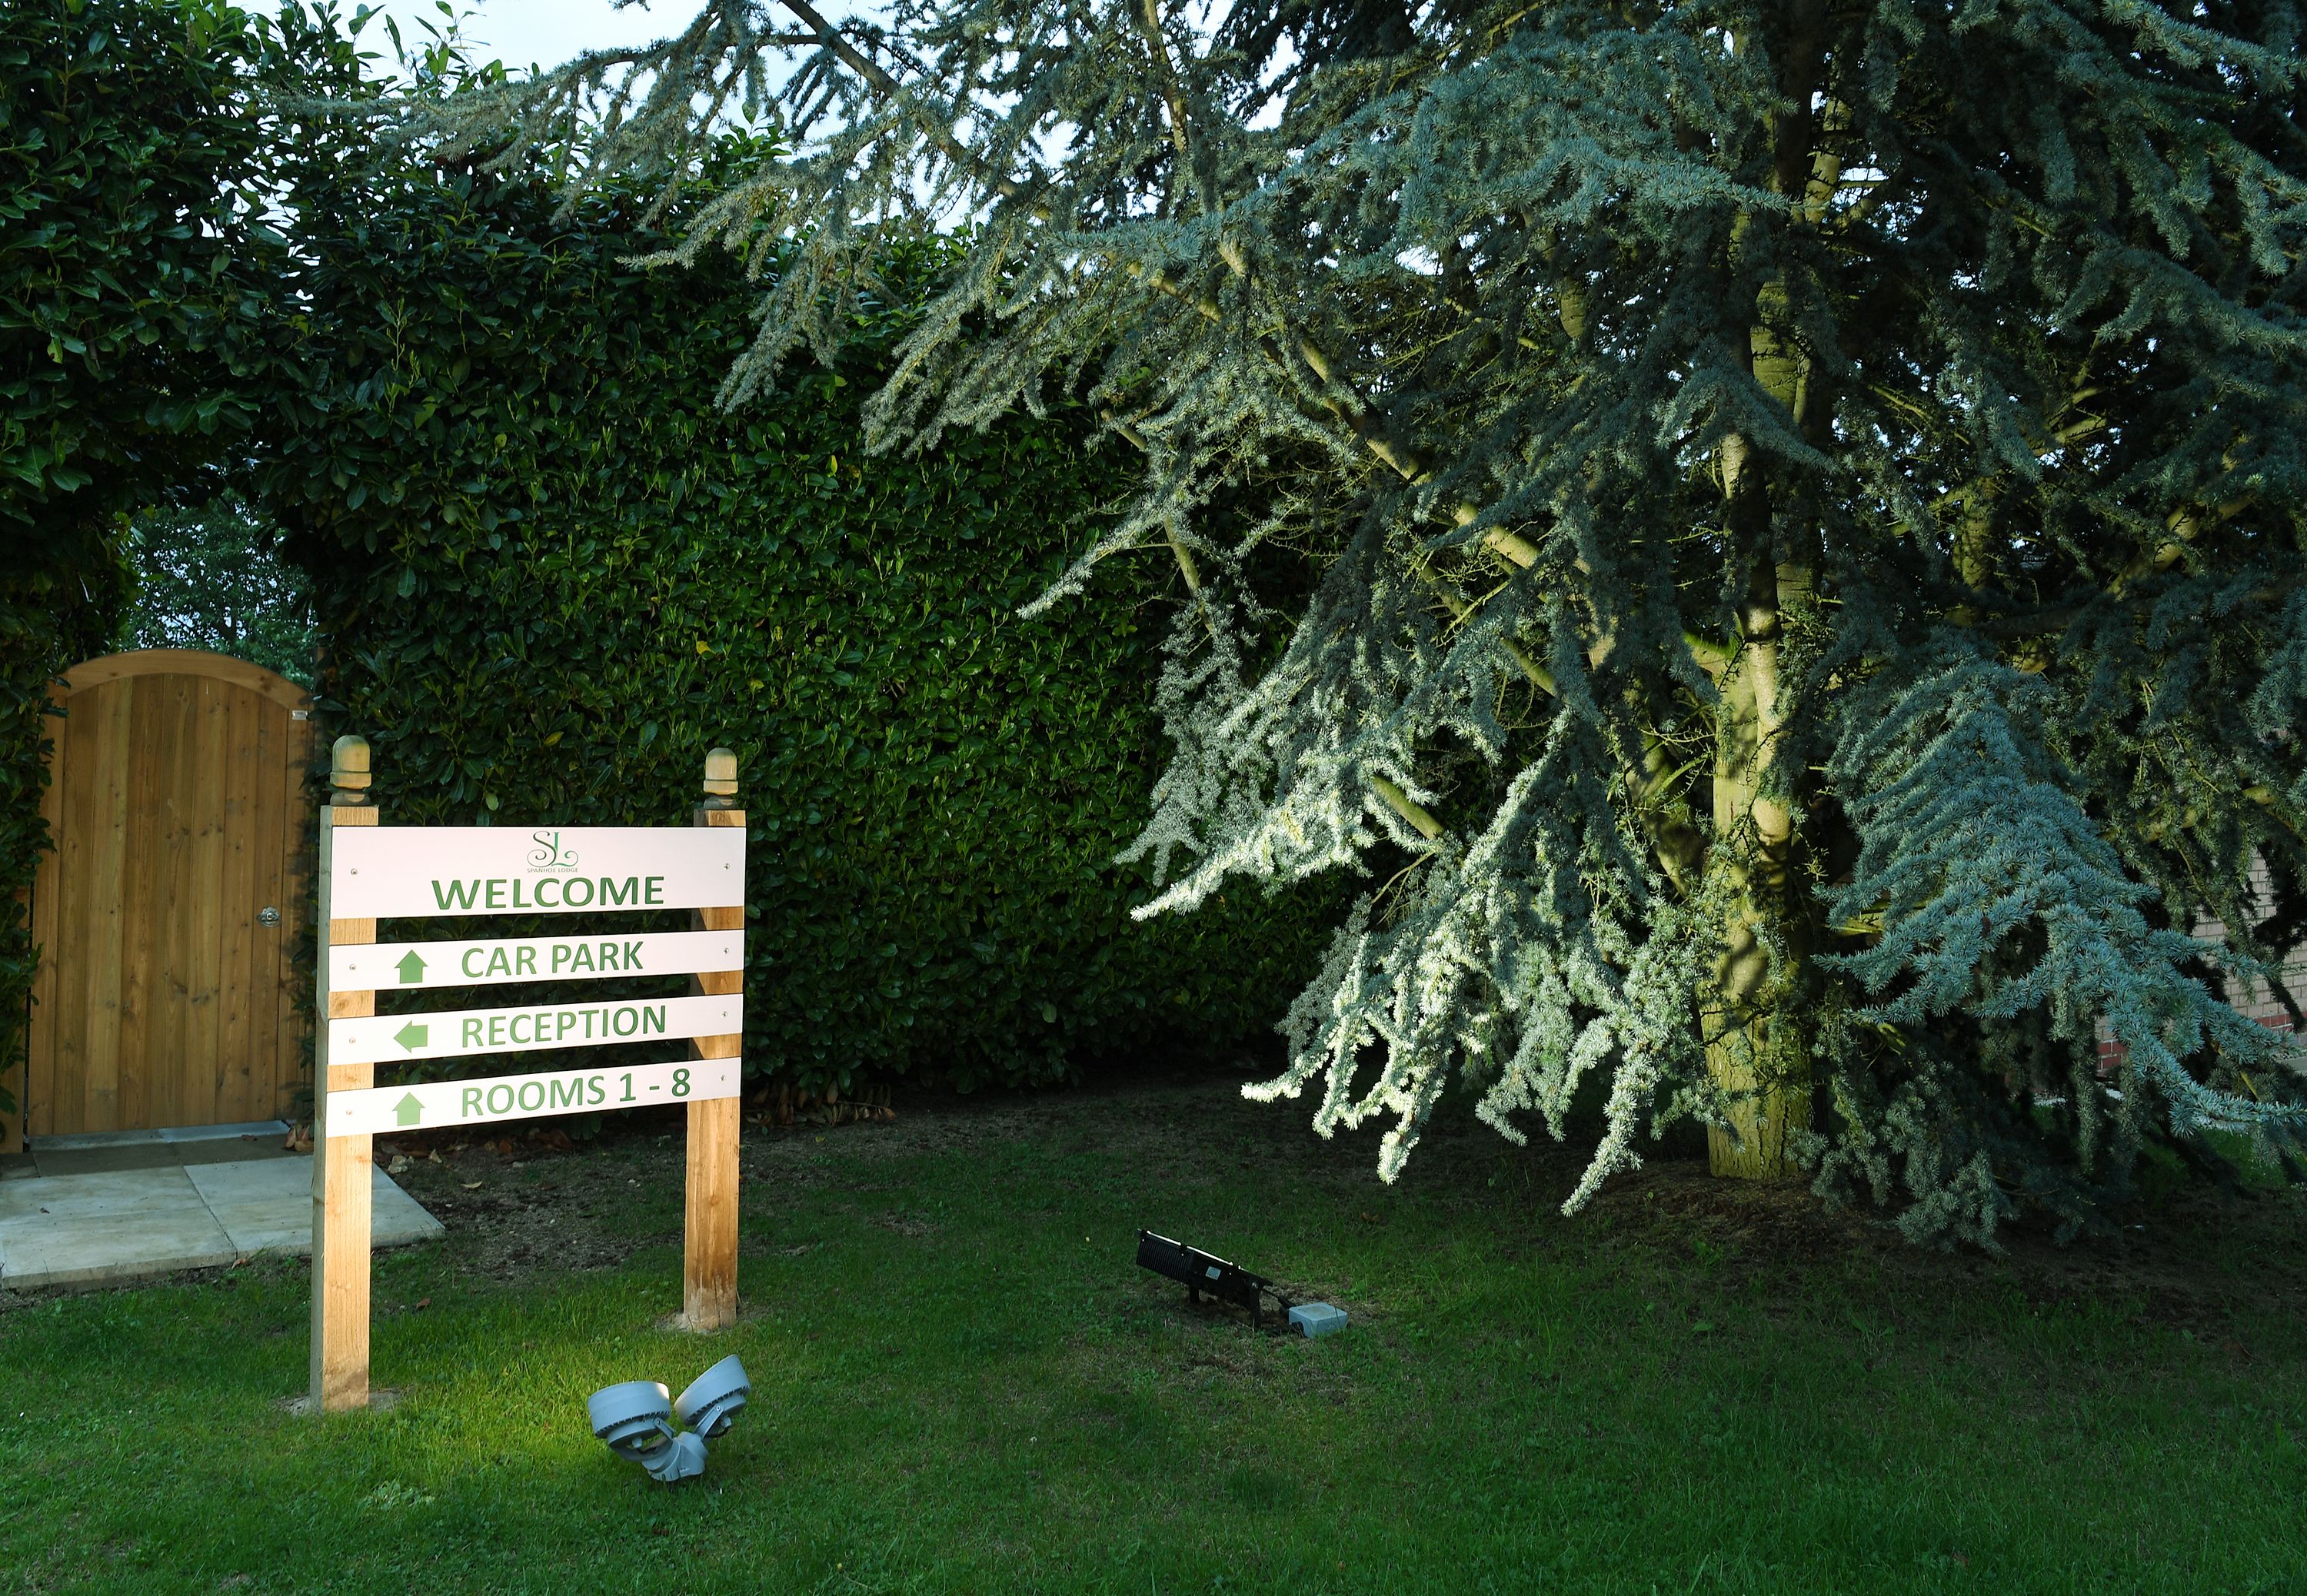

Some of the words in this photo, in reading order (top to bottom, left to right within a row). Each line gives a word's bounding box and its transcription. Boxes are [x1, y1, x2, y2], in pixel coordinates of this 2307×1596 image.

[431, 876, 665, 911] WELCOME
[461, 946, 538, 978] CAR
[551, 941, 644, 973] PARK
[461, 1005, 667, 1048] RECEPTION
[461, 1075, 606, 1117] ROOMS
[619, 1072, 637, 1102] 1
[671, 1068, 691, 1098] 8
